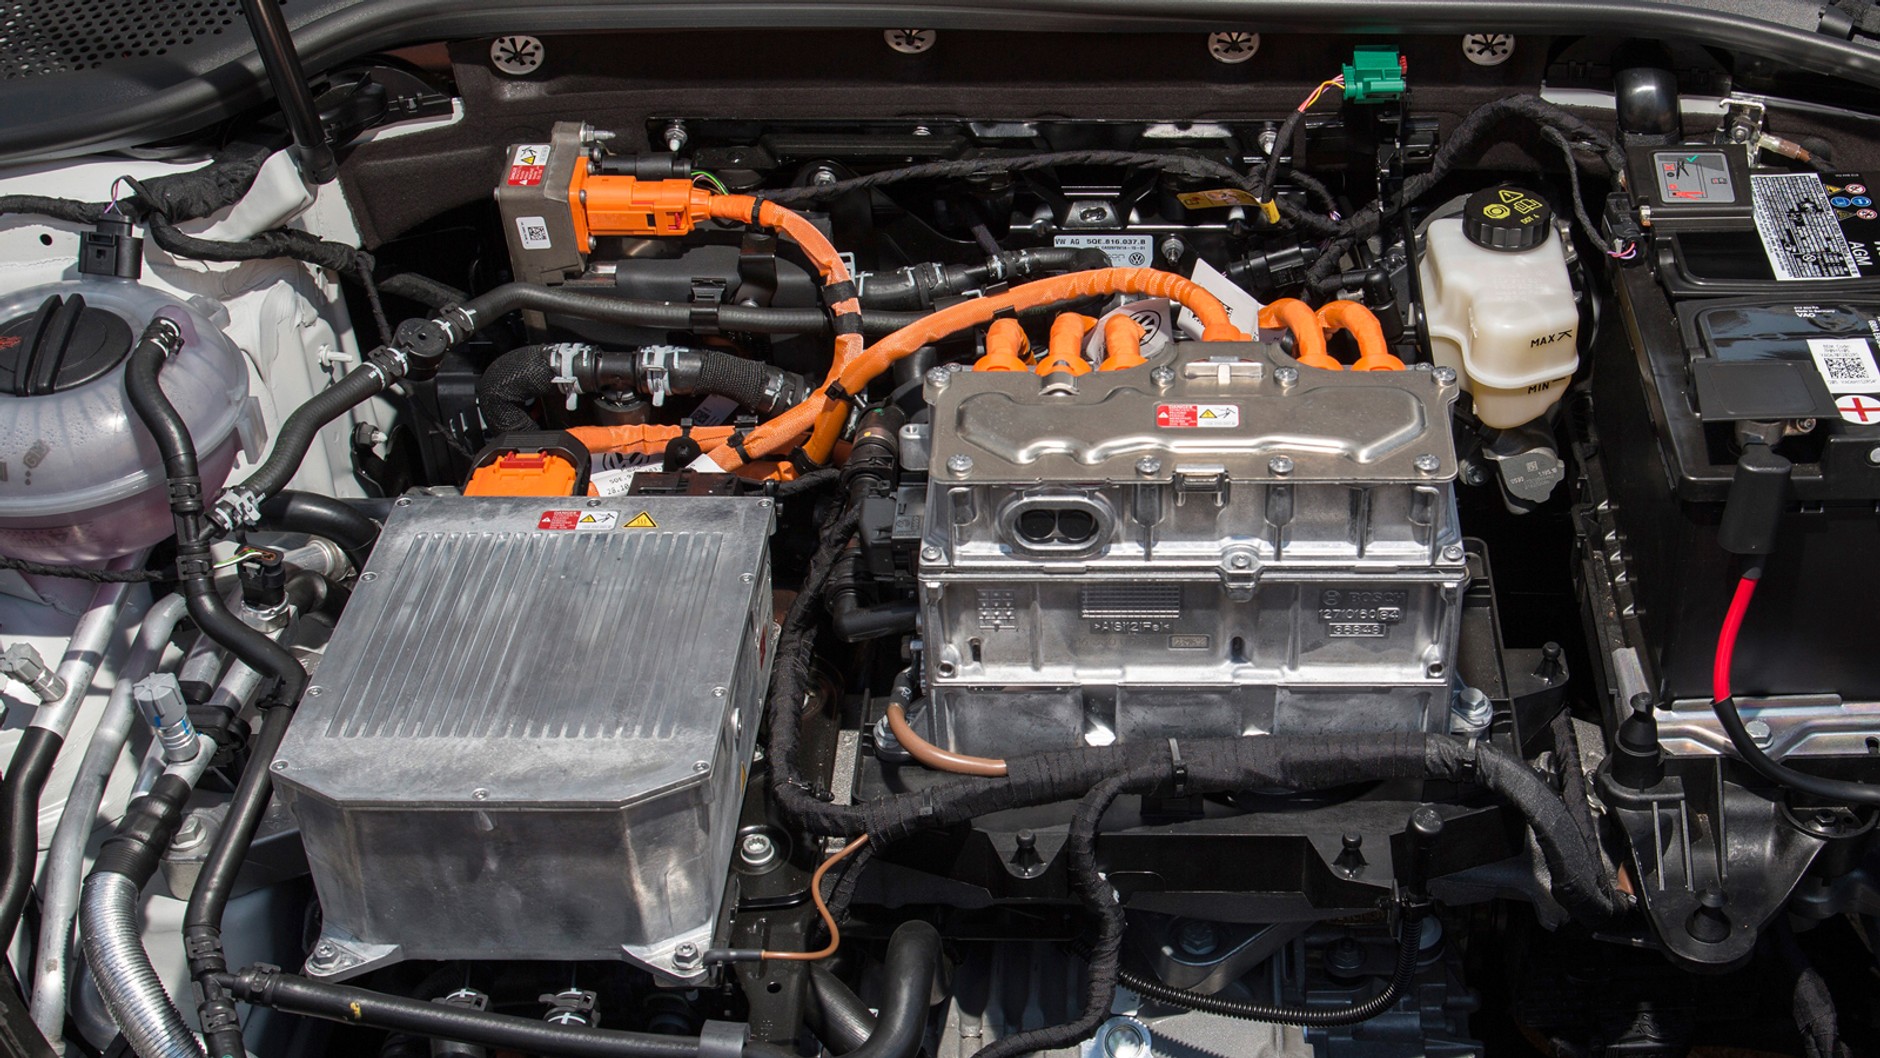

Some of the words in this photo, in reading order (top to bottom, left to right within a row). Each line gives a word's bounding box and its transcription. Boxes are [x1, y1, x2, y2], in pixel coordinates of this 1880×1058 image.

[1849, 241, 1873, 266] AGM
[1530, 333, 1555, 348] MAX
[1527, 382, 1550, 394] MIN
[1349, 591, 1407, 602] BOSCH
